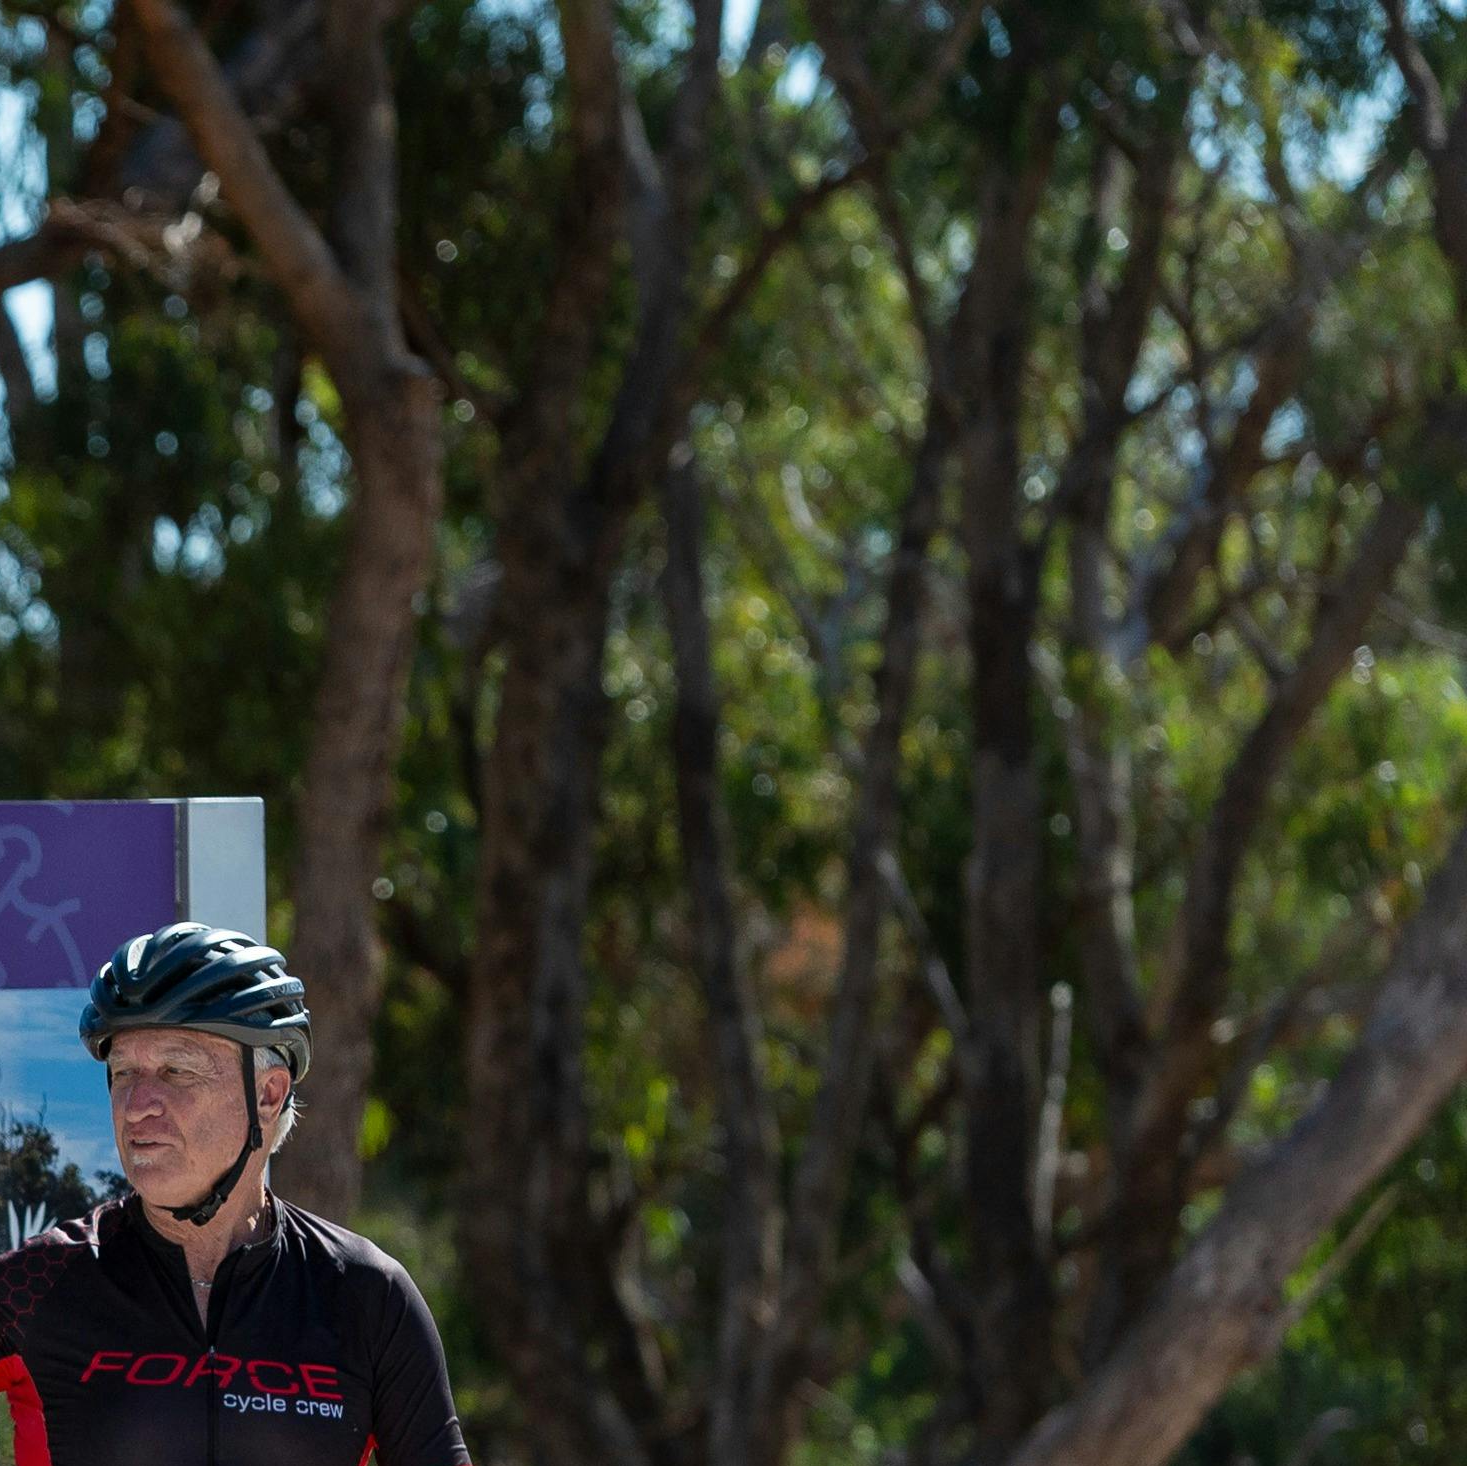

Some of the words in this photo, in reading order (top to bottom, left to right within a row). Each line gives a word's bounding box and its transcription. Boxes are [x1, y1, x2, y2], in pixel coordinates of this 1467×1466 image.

[79, 1351, 344, 1400] FORCE
[223, 1393, 287, 1413] cycle
[295, 1399, 345, 1419] crew
